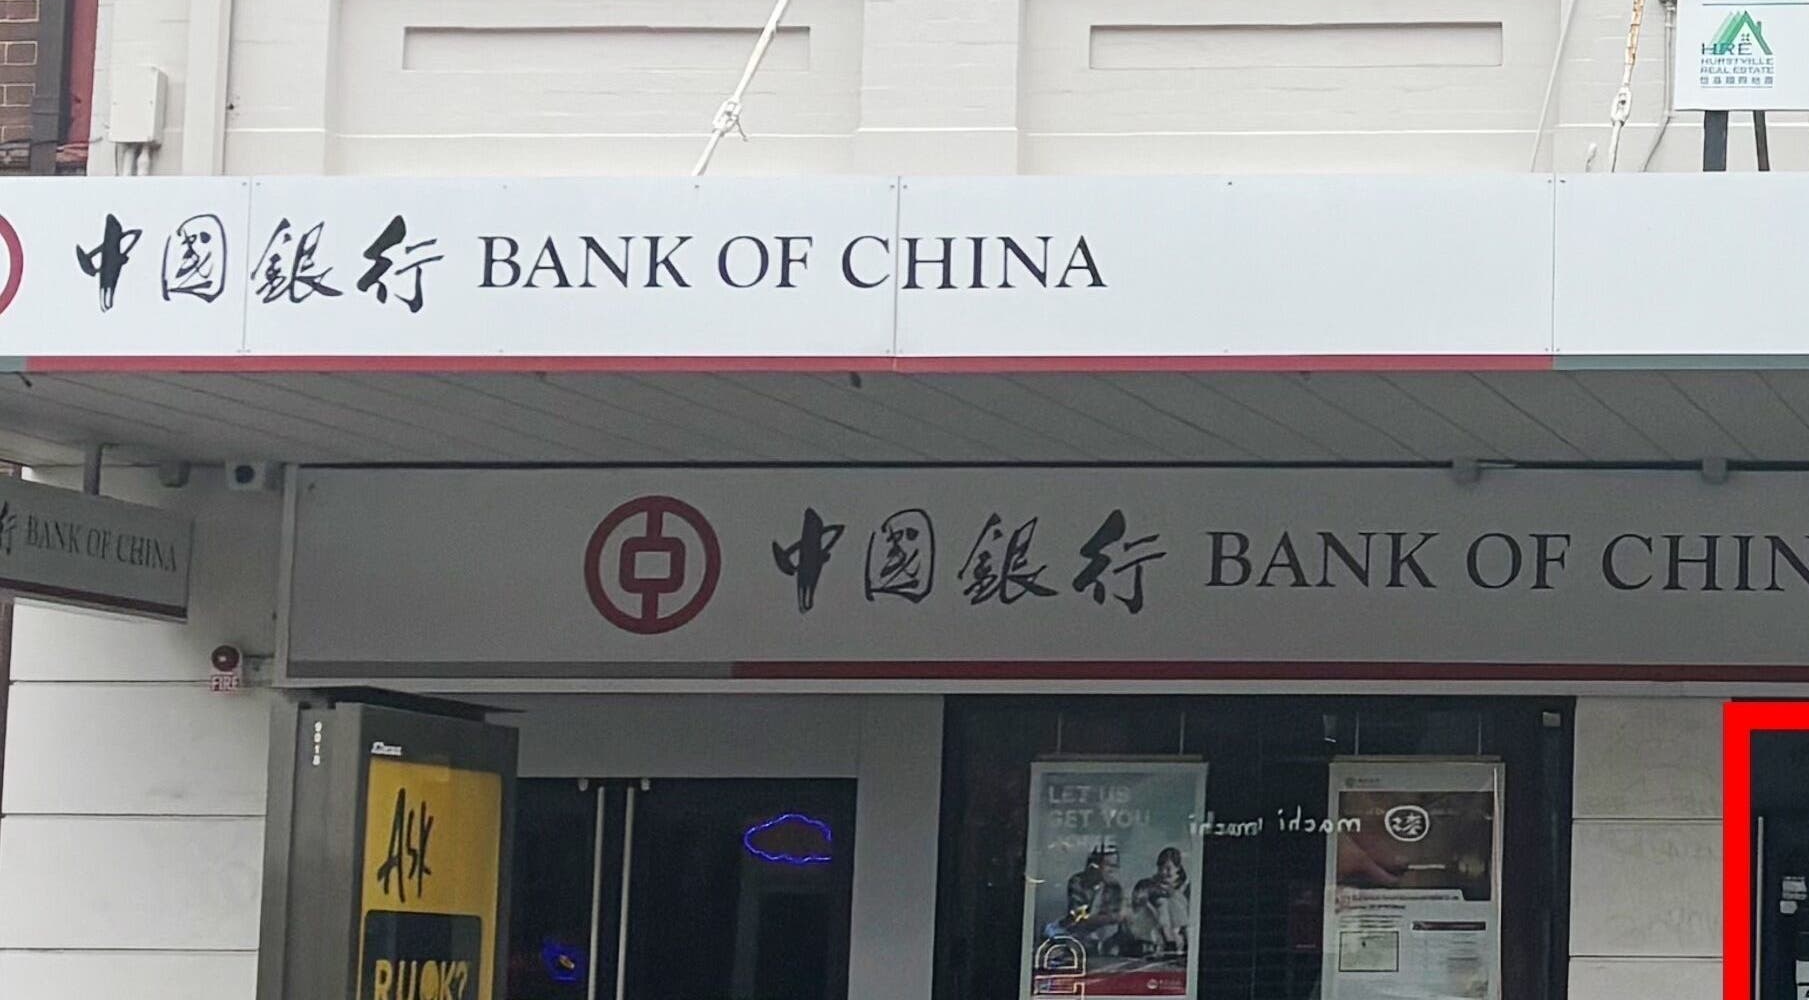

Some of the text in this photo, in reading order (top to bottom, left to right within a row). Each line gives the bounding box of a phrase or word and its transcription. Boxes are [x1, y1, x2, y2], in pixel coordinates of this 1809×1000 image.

[1701, 42, 1753, 56] HRE
[476, 235, 1109, 290] BANK OF CHINA
[27, 514, 177, 572] BANK OF CHINA
[1205, 530, 1439, 589] BANK
[1465, 532, 1572, 590] OF
[211, 674, 240, 692] FIRE
[1048, 785, 1091, 804] LET
